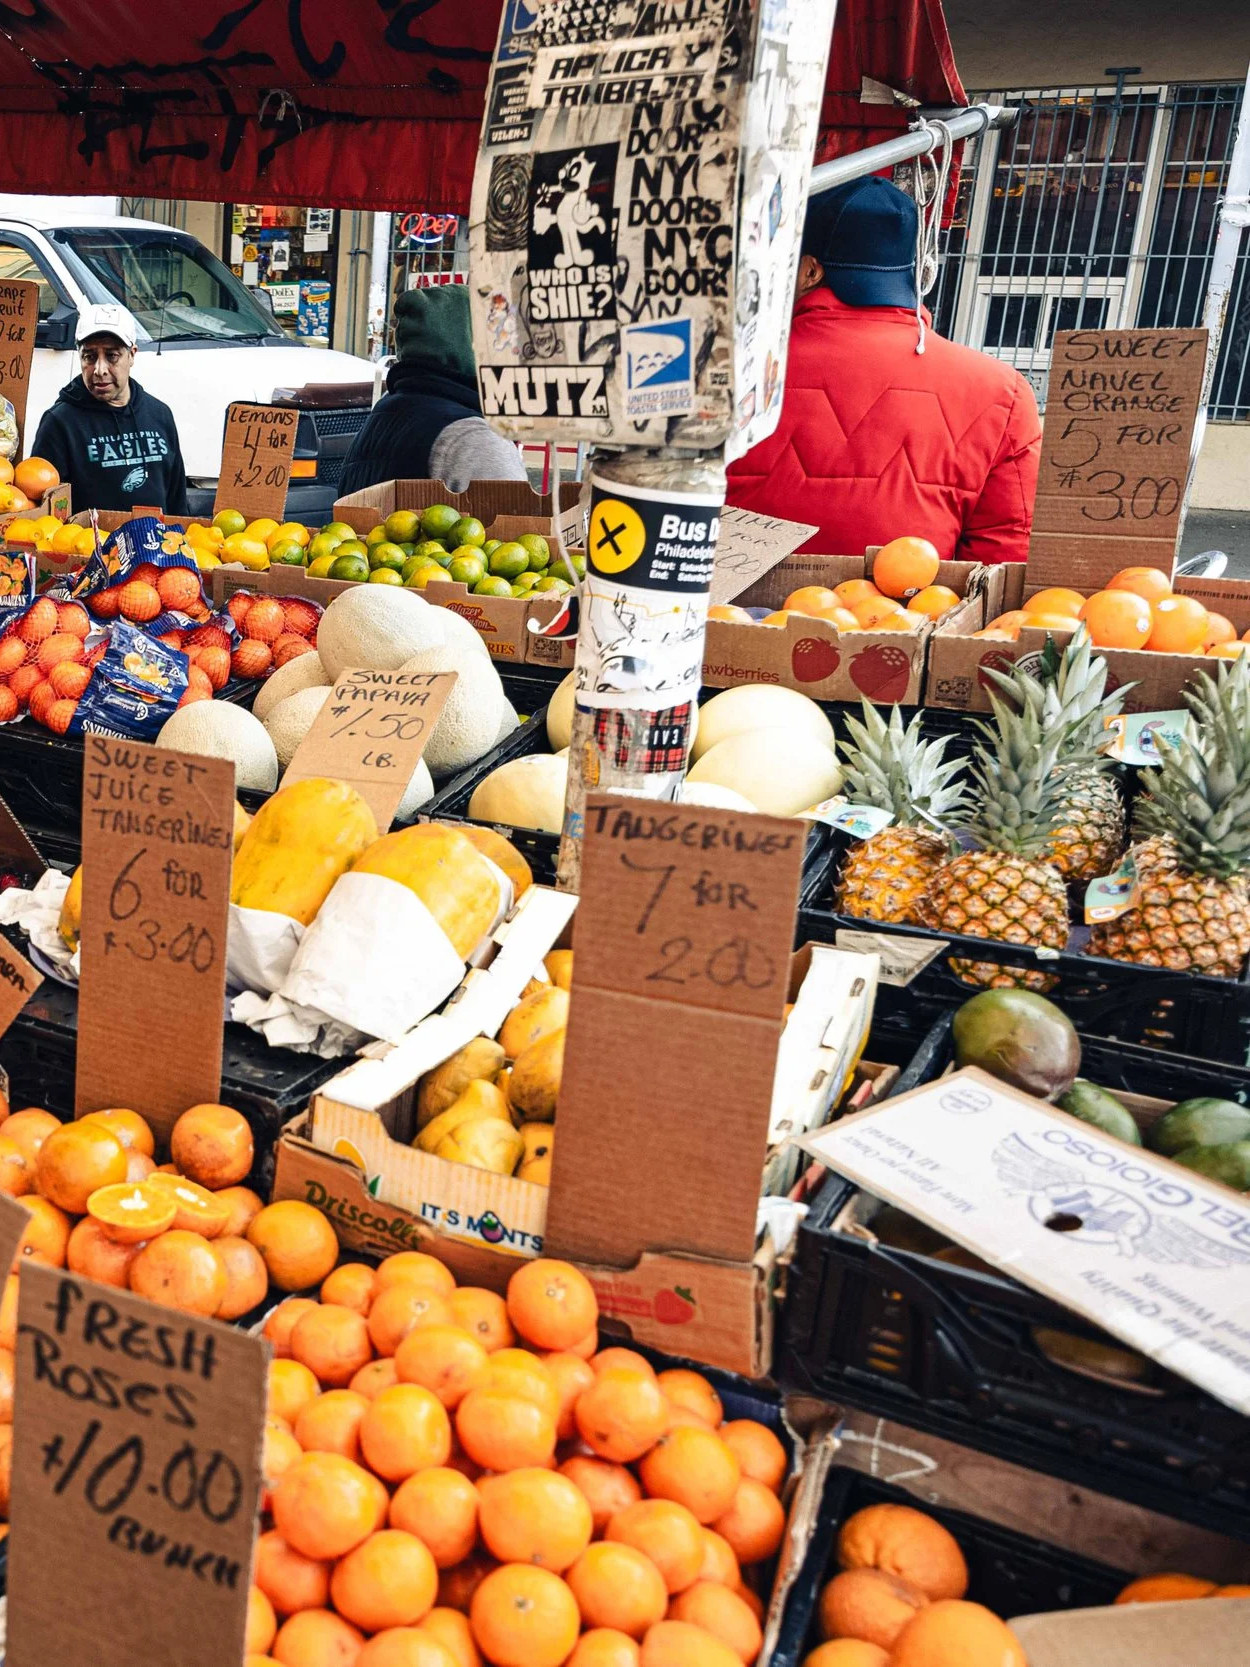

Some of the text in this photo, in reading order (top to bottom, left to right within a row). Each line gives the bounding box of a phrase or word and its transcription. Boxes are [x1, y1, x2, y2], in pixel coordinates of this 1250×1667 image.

[630, 154, 700, 198] NY
[628, 197, 721, 226] DOORS
[644, 225, 733, 269] NYC
[530, 266, 611, 288] WHO IS
[530, 285, 614, 321] SHIE?
[1065, 332, 1205, 362] SWEET
[481, 366, 606, 416] MUTZ
[1061, 370, 1169, 392] NAVEL
[1064, 392, 1185, 413] ORANGE
[87, 438, 168, 461] EAGLES
[243, 425, 262, 470] 4
[1051, 418, 1182, 468] 5 FOR
[659, 514, 708, 541] Bus
[347, 670, 448, 686] SWEET
[335, 685, 431, 706] PAPAYA
[91, 738, 207, 784] SWEET
[86, 772, 175, 806] JUICE
[109, 848, 147, 920] 6
[620, 853, 676, 934] 7
